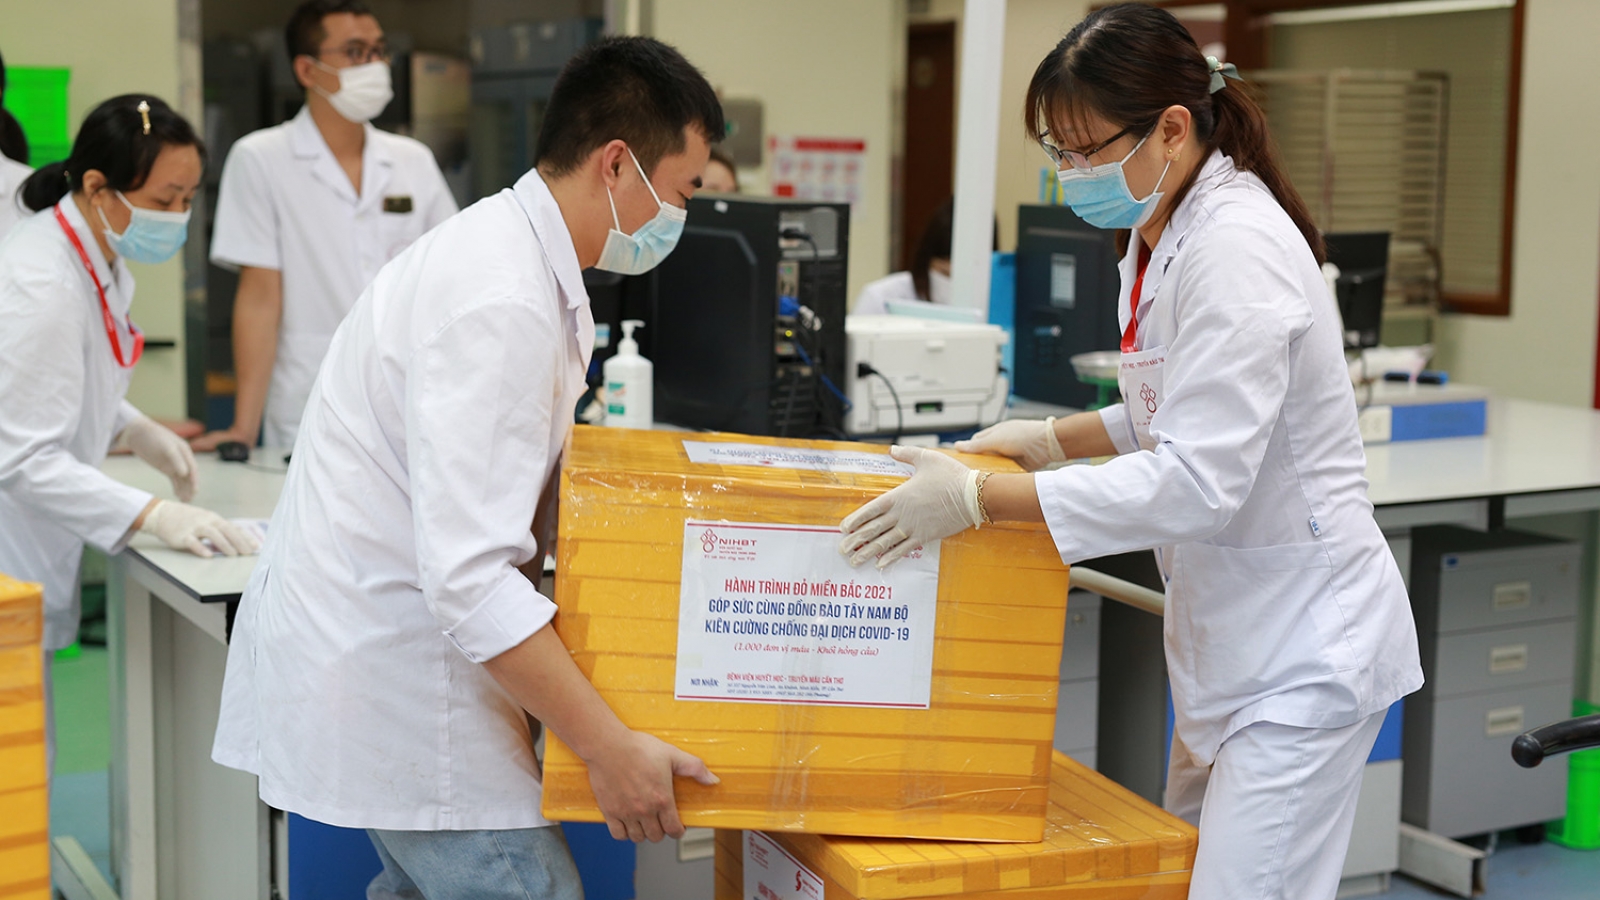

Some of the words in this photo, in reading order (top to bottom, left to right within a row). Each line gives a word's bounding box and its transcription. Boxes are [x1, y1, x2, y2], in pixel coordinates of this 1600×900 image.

[719, 538, 757, 547] NIHBT
[724, 576, 755, 593] HÀNH
[758, 578, 790, 595] TRÌNH
[793, 578, 808, 596] ĐỎ
[810, 579, 838, 597] MIỀN
[840, 579, 862, 598] BẮC
[864, 585, 892, 600] 2021
[708, 597, 731, 613] GÓP
[732, 598, 754, 614] SỨC
[756, 598, 785, 615] CÙNG
[787, 599, 817, 616] ĐỒNG
[819, 601, 841, 618] BÀO
[844, 603, 865, 619] TÂY
[866, 605, 892, 620] NAM
[894, 604, 909, 622] BỘ
[705, 617, 731, 634] KIÊN
[733, 618, 769, 635] CƯỜNG
[771, 619, 808, 637] CHỐNG
[810, 624, 829, 640] ĐẠI
[831, 625, 857, 641] DỊCH
[859, 626, 910, 641] COVID-19
